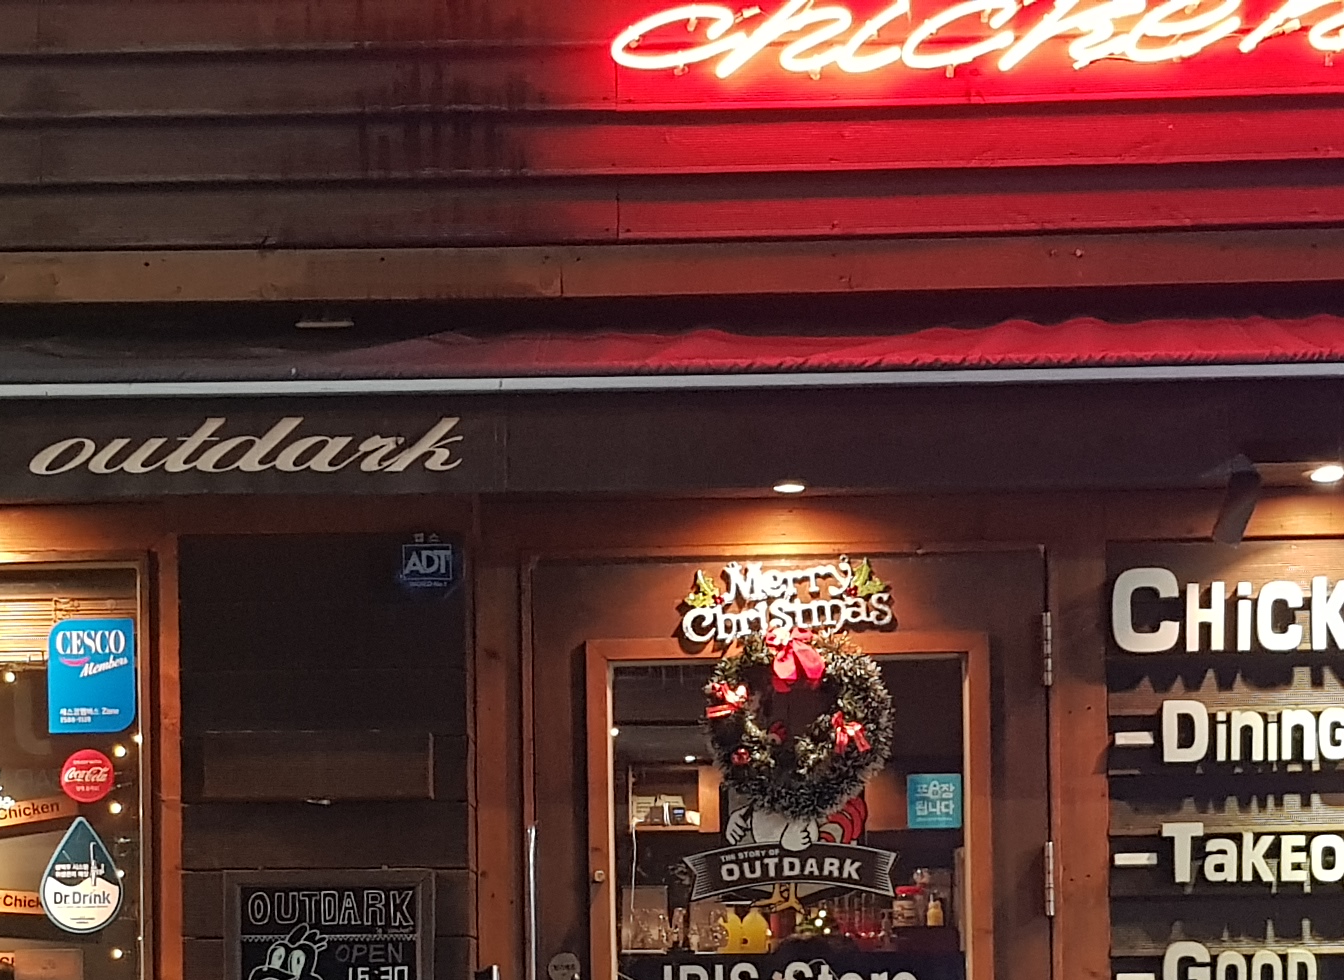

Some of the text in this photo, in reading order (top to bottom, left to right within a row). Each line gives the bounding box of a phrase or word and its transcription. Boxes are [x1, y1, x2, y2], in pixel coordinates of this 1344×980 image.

[29, 416, 464, 476] outdark
[403, 550, 452, 574] ADT
[723, 558, 854, 604] Merry
[682, 591, 892, 643] Christmas
[56, 629, 126, 655] CESCO
[79, 654, 129, 678] Members
[738, 850, 766, 860] STORY
[721, 856, 862, 881] OUTDARK
[248, 890, 414, 926] OUTDARK
[336, 943, 405, 964] OPEN
